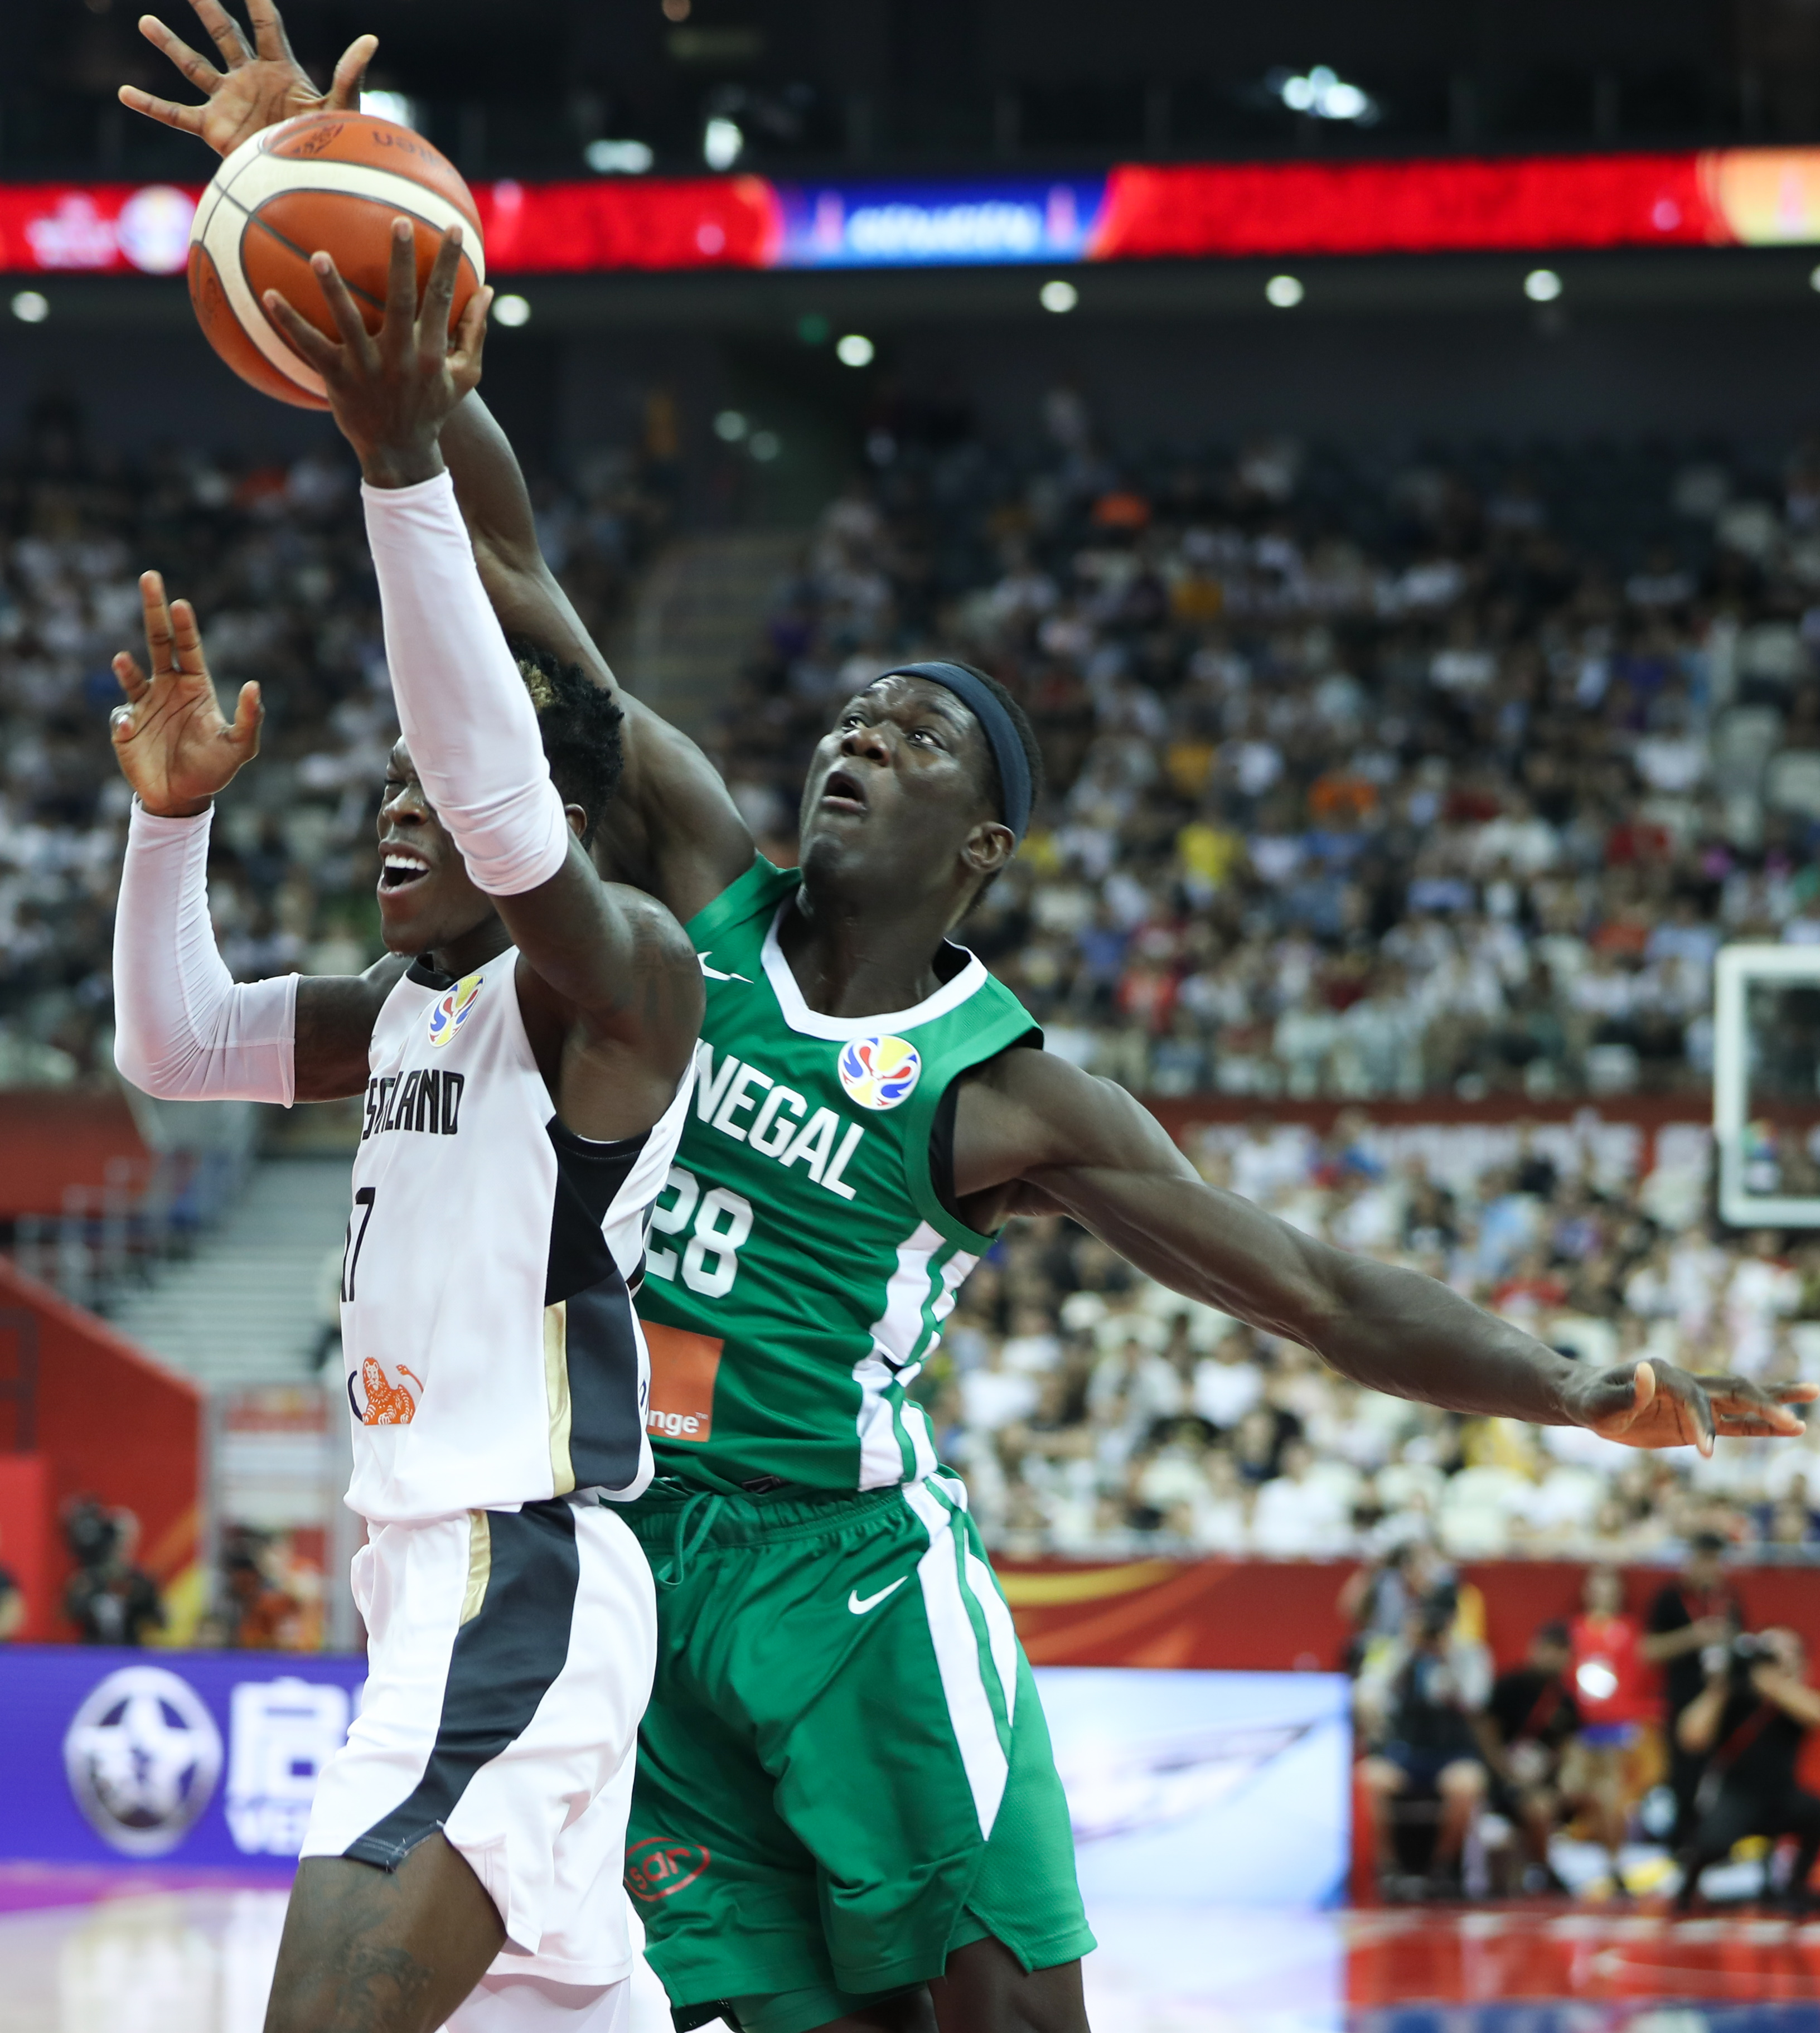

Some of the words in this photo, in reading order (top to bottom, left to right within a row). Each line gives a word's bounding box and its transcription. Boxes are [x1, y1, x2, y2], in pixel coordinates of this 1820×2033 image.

[695, 1038, 865, 1201] NEGAL
[644, 1166, 754, 1299] 28
[228, 1676, 363, 1798] 启
